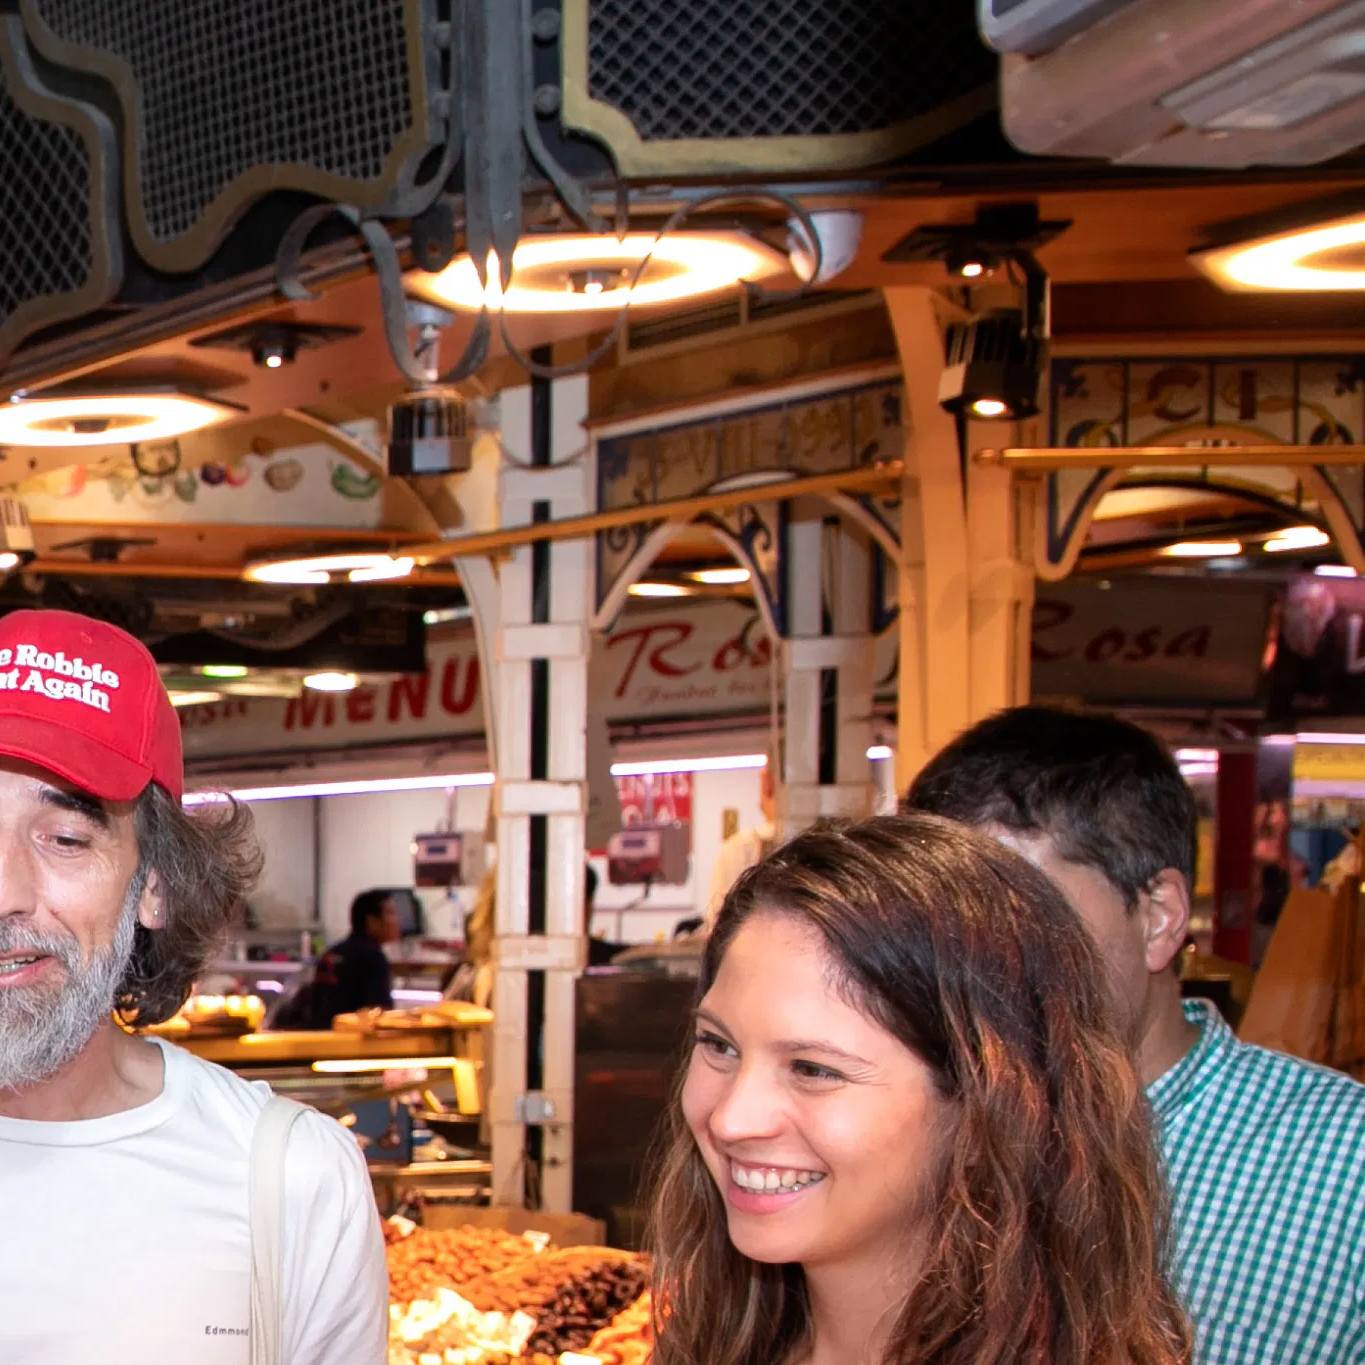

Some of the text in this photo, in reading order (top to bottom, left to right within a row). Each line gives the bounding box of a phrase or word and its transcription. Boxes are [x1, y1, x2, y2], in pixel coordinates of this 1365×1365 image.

[13, 644, 120, 689] Robbie
[605, 621, 771, 699] Ros
[20, 670, 111, 714] Again
